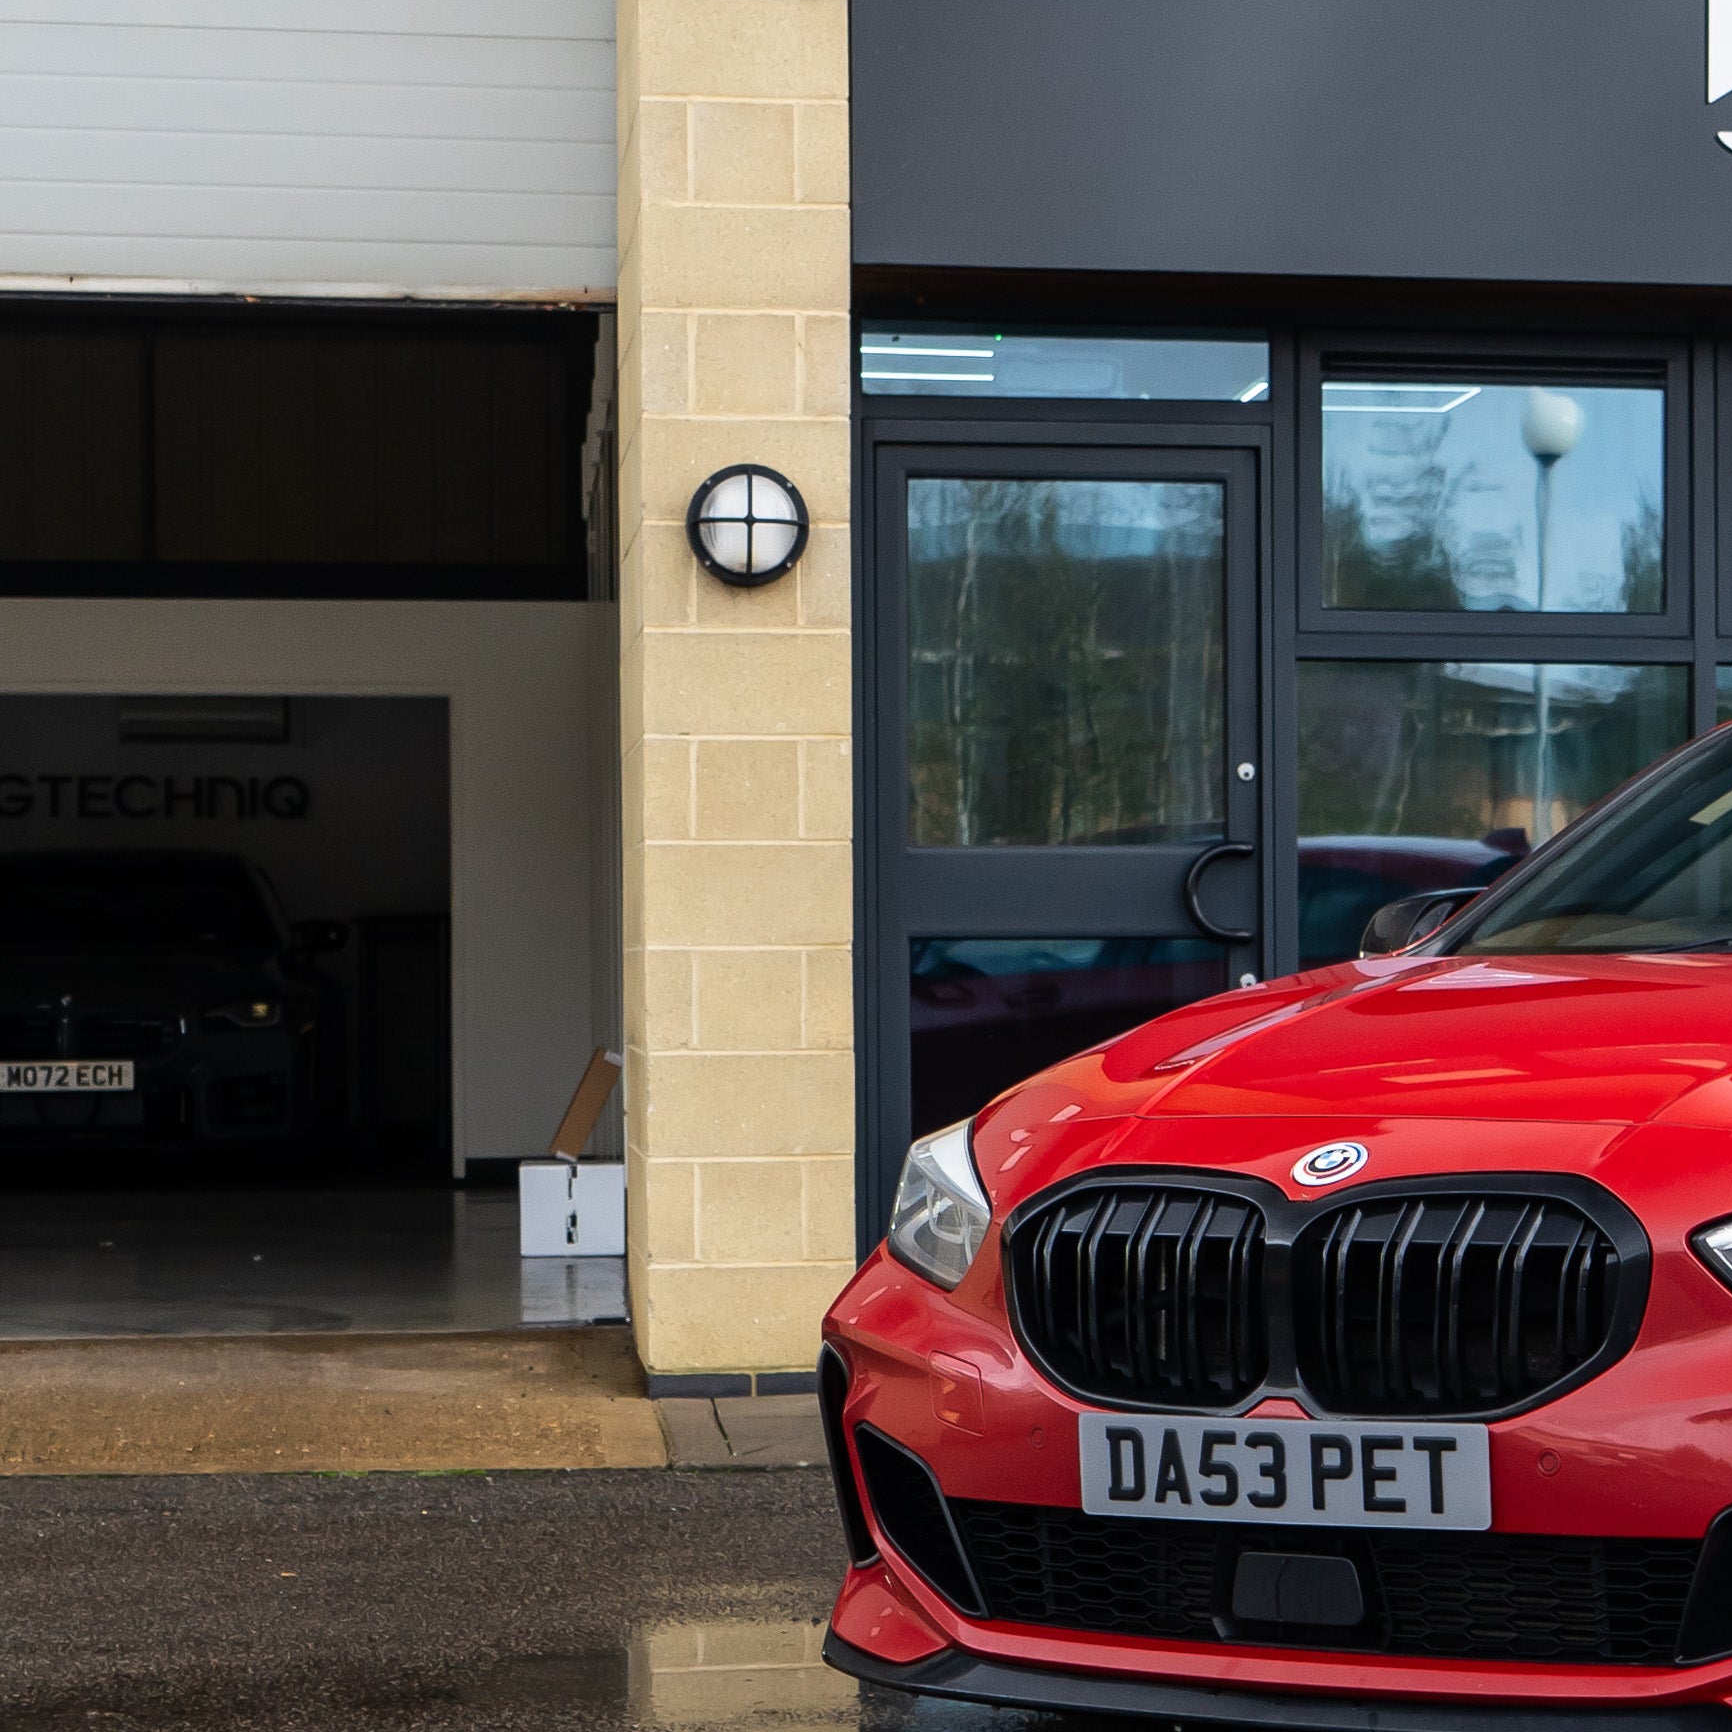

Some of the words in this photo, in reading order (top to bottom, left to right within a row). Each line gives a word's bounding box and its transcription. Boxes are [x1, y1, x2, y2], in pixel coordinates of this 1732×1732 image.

[76, 1065, 122, 1087] ECH
[1105, 1425, 1288, 1508] DA53
[1310, 1433, 1458, 1515] PET
